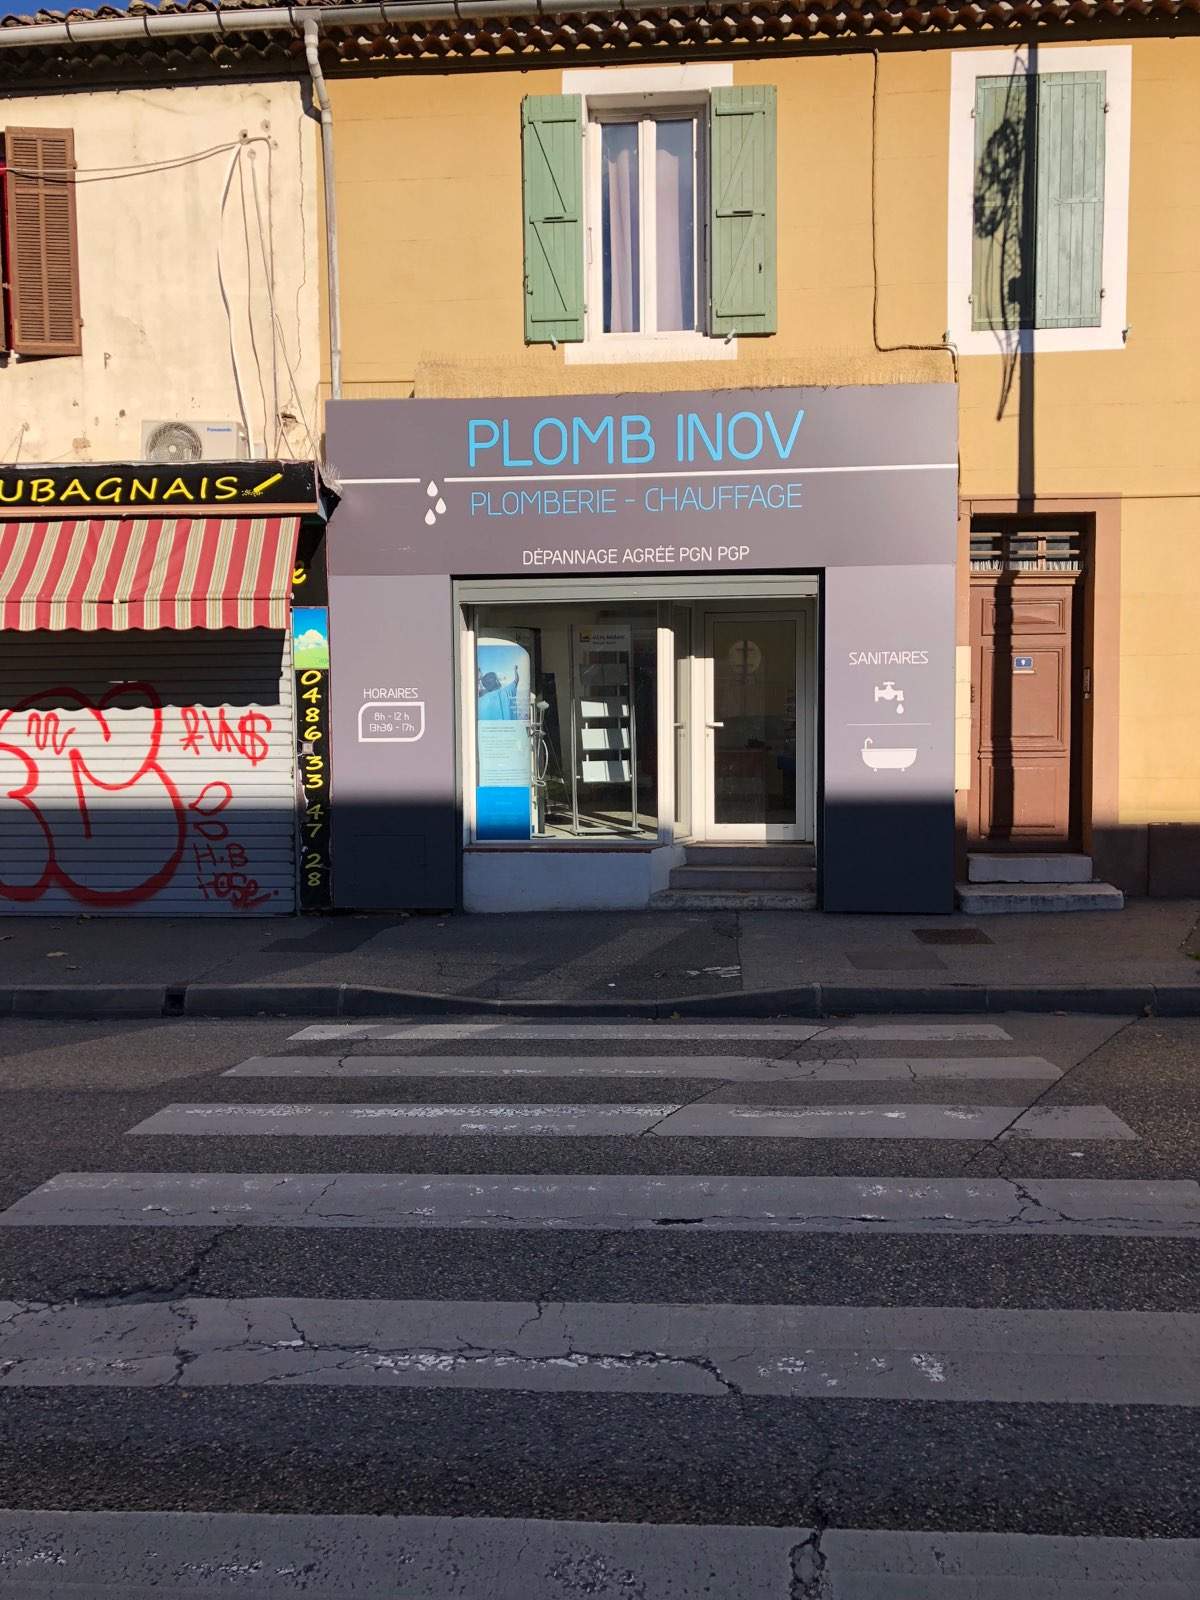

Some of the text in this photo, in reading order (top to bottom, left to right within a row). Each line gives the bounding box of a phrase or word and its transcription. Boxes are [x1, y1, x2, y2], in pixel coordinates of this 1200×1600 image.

[468, 410, 805, 468] PLOMB INOV
[470, 489, 617, 516] PLOMBERIE
[644, 483, 803, 513] CHAUFFAGE
[522, 544, 750, 566] DÉPANNAGE AGRÉÉ PGN PGP
[849, 651, 929, 666] SANITAIRES
[363, 687, 419, 699] HORAIRES
